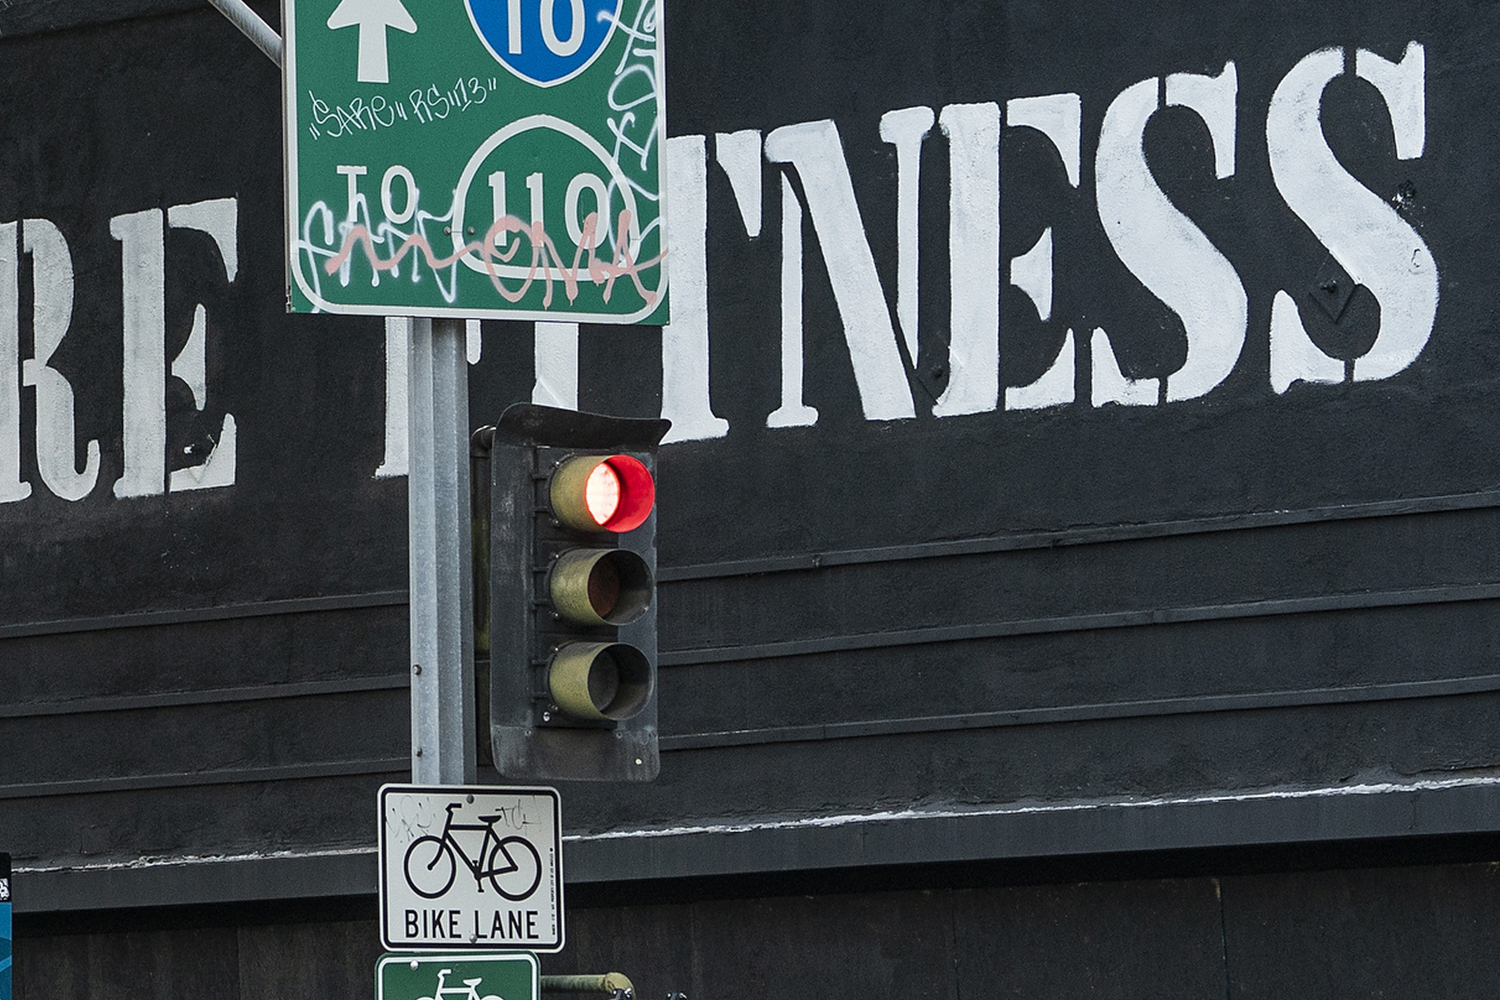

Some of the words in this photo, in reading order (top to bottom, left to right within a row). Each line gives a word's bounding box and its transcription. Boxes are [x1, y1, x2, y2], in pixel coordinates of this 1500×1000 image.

[336, 164, 417, 225] TO
[488, 170, 610, 250] 110
[405, 909, 462, 938] BIKE
[475, 910, 539, 939] LANE
